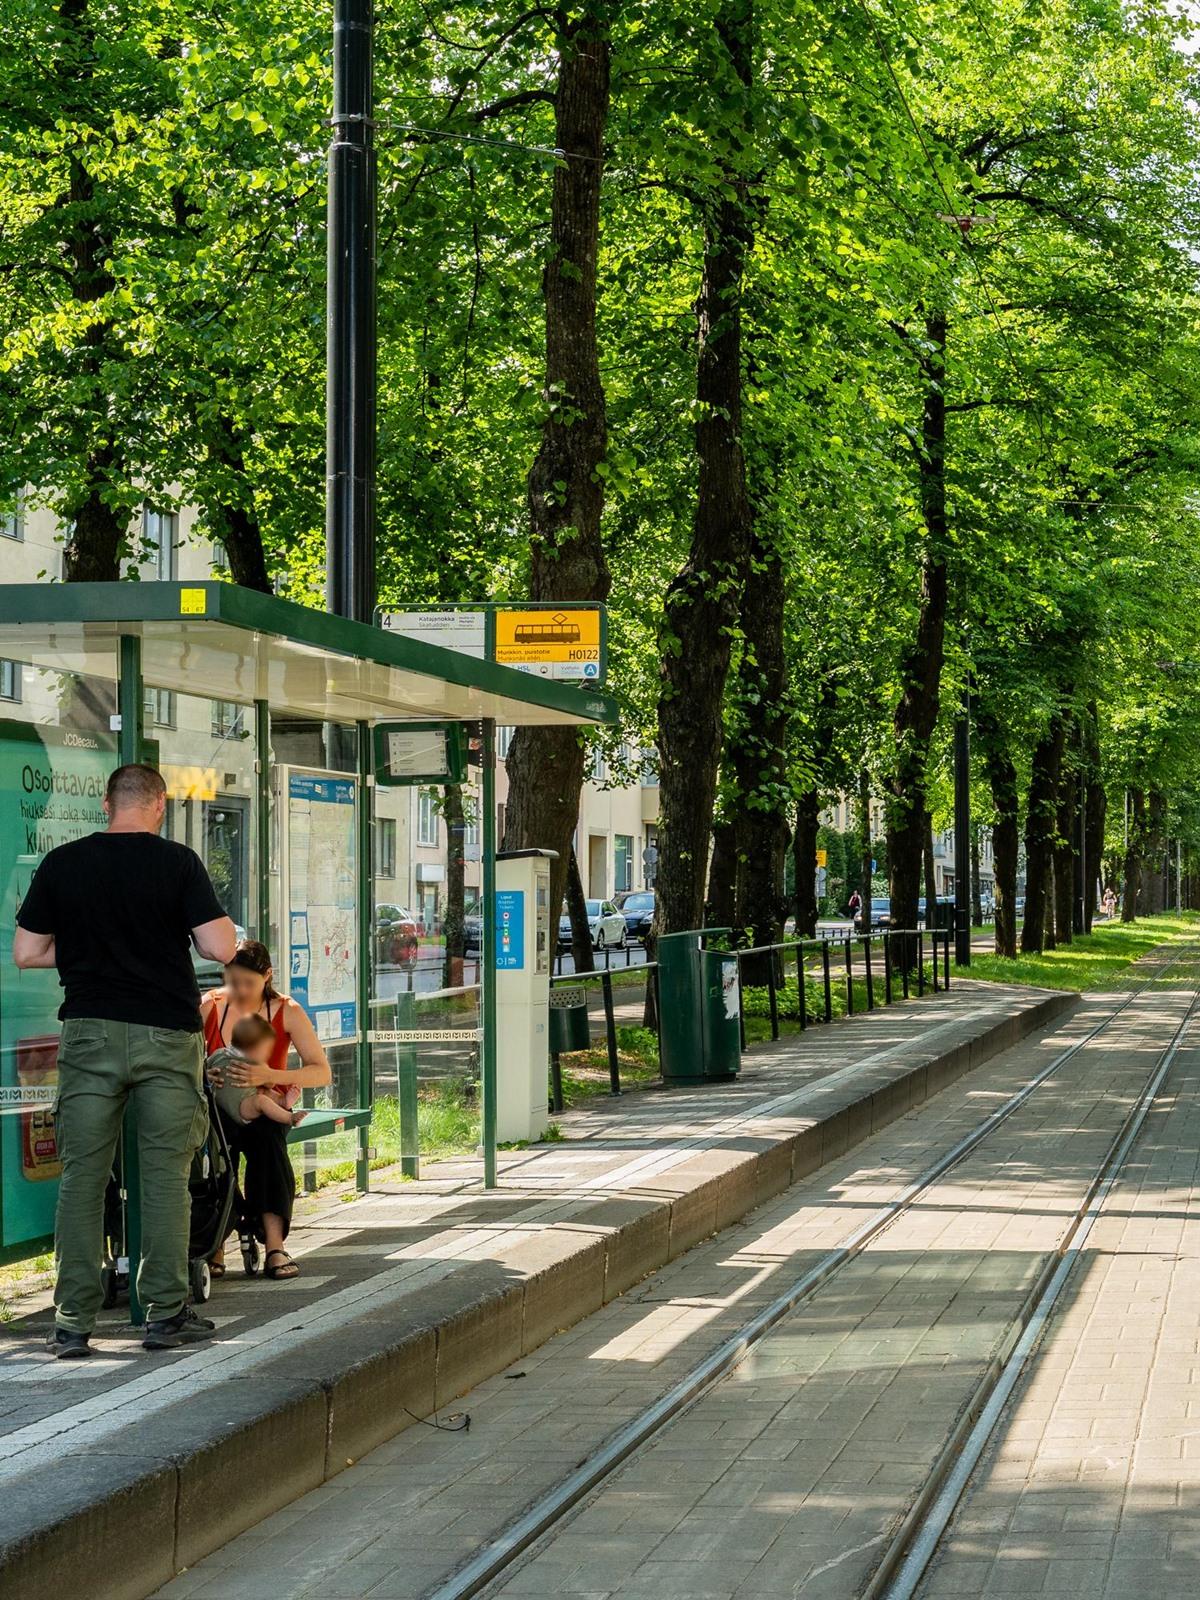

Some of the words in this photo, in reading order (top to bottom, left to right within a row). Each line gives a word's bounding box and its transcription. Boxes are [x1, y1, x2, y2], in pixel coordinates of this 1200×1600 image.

[383, 614, 392, 628] 4
[568, 649, 599, 660] H0122
[586, 665, 595, 675] A
